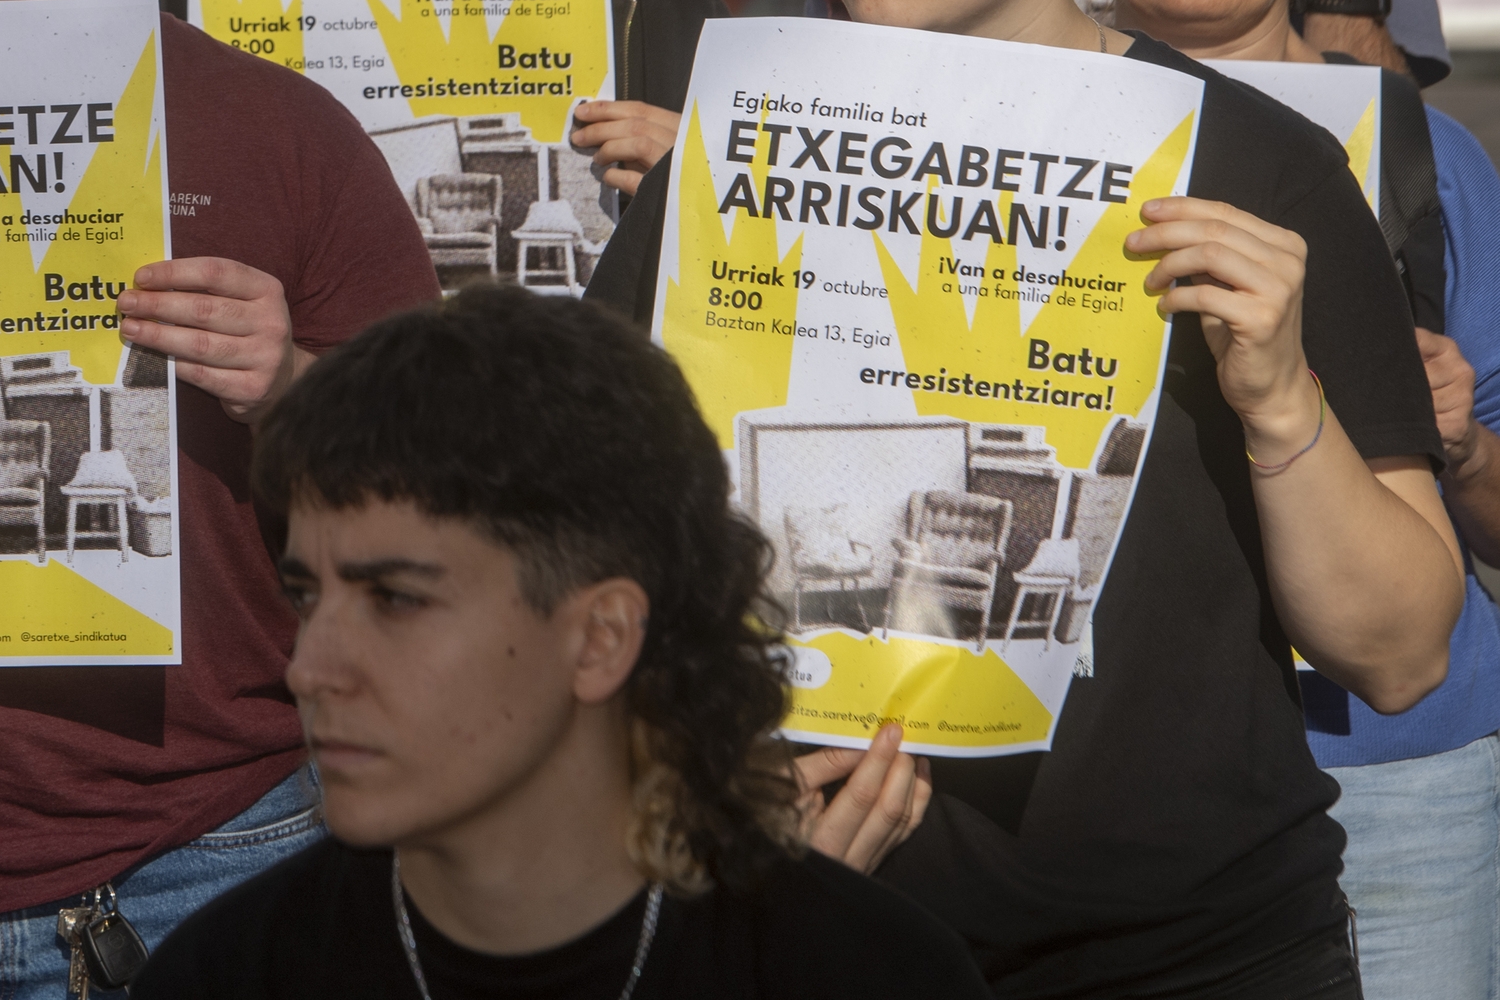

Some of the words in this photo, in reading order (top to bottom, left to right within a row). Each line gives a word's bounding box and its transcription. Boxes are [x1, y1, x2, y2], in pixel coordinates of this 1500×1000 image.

[229, 16, 290, 34] Urriak
[297, 15, 317, 31] 19
[322, 17, 378, 32] octubre
[420, 8, 430, 18] a
[433, 7, 460, 17] una
[463, 3, 511, 16] familia
[514, 3, 532, 16] de
[535, 2, 571, 19] Egia!
[328, 55, 348, 70] 13,
[352, 54, 385, 72] Egia
[498, 44, 571, 69] Batu
[362, 74, 572, 100] erresistentziara!
[732, 90, 803, 115] Egiako
[810, 97, 884, 123] familia
[890, 106, 927, 128] bat
[726, 120, 1133, 204] ETXEGABETZE
[1, 215, 14, 226] a
[19, 208, 124, 226] desahuciar
[718, 173, 1070, 252] ARRISKUAN!
[5, 227, 58, 243] familia
[62, 227, 81, 241] de
[85, 226, 124, 245] Egia!
[44, 273, 125, 300] Batu
[711, 260, 784, 287] Urriak
[792, 269, 816, 290] 19
[822, 280, 889, 299] octubre
[938, 256, 985, 278] ¡Van
[992, 268, 1005, 280] a
[1012, 265, 1126, 293] desahuciar
[708, 286, 763, 311] 8:00
[941, 282, 953, 293] a
[957, 284, 989, 297] una
[994, 283, 1051, 304] familia
[1055, 290, 1076, 307] de
[1081, 292, 1124, 314] Egia!
[705, 310, 766, 333] Baztan
[771, 318, 818, 339] Kalea
[824, 324, 846, 343] 13,
[852, 327, 891, 349] Egia
[1027, 338, 1117, 378] Batu
[860, 366, 1114, 411] erresistentziara!
